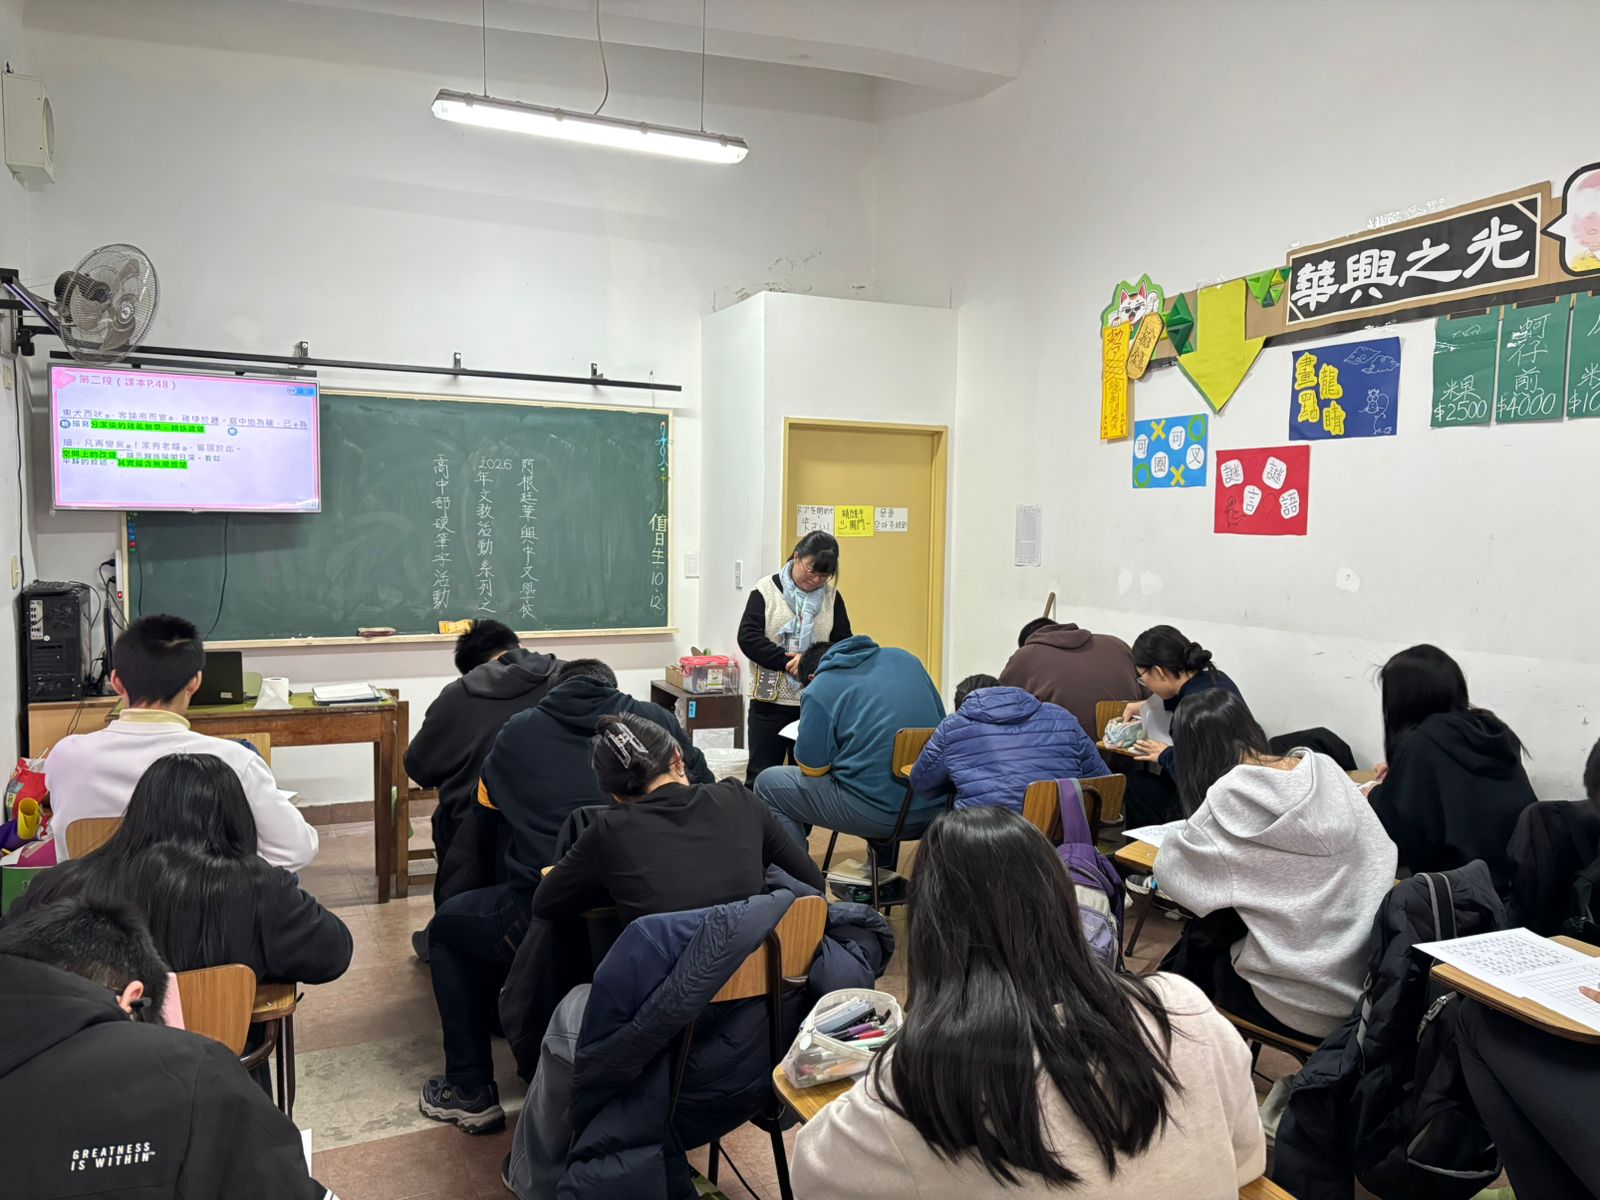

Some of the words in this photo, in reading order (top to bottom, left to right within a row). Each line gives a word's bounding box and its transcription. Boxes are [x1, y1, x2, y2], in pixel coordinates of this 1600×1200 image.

[1291, 216, 1529, 311] 華興之光
[1434, 400, 1487, 422] $2500
[1498, 392, 1556, 419] $4000
[72, 1142, 151, 1160] GREATNESS
[70, 1159, 87, 1172] IS
